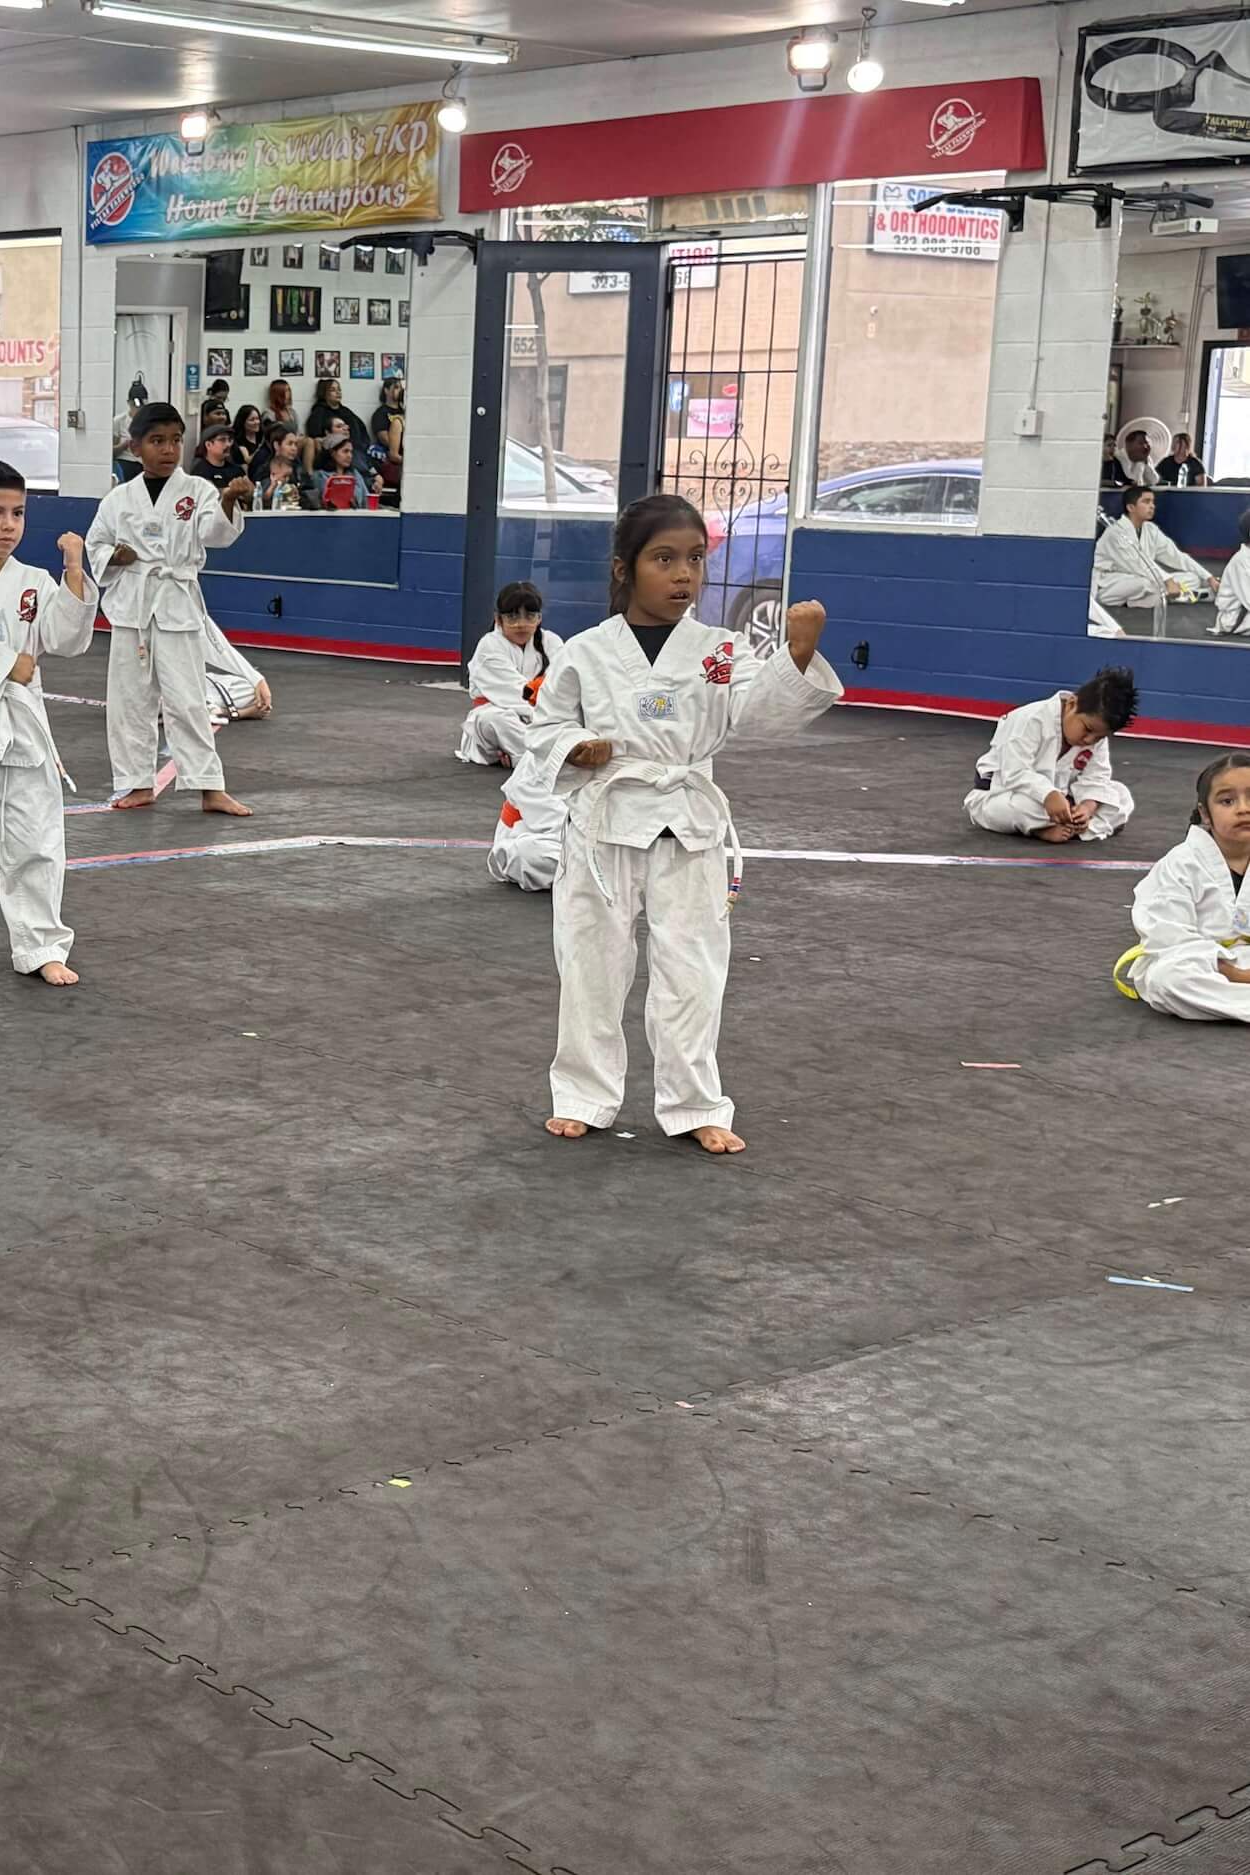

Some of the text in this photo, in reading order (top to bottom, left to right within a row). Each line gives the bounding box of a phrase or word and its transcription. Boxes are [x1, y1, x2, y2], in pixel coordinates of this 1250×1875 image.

[285, 127, 366, 166] Villa's
[165, 193, 227, 223] Home
[235, 187, 261, 221] of
[268, 177, 408, 217] Champions
[877, 213, 886, 231] &
[890, 211, 999, 240] ORTHODONTICS
